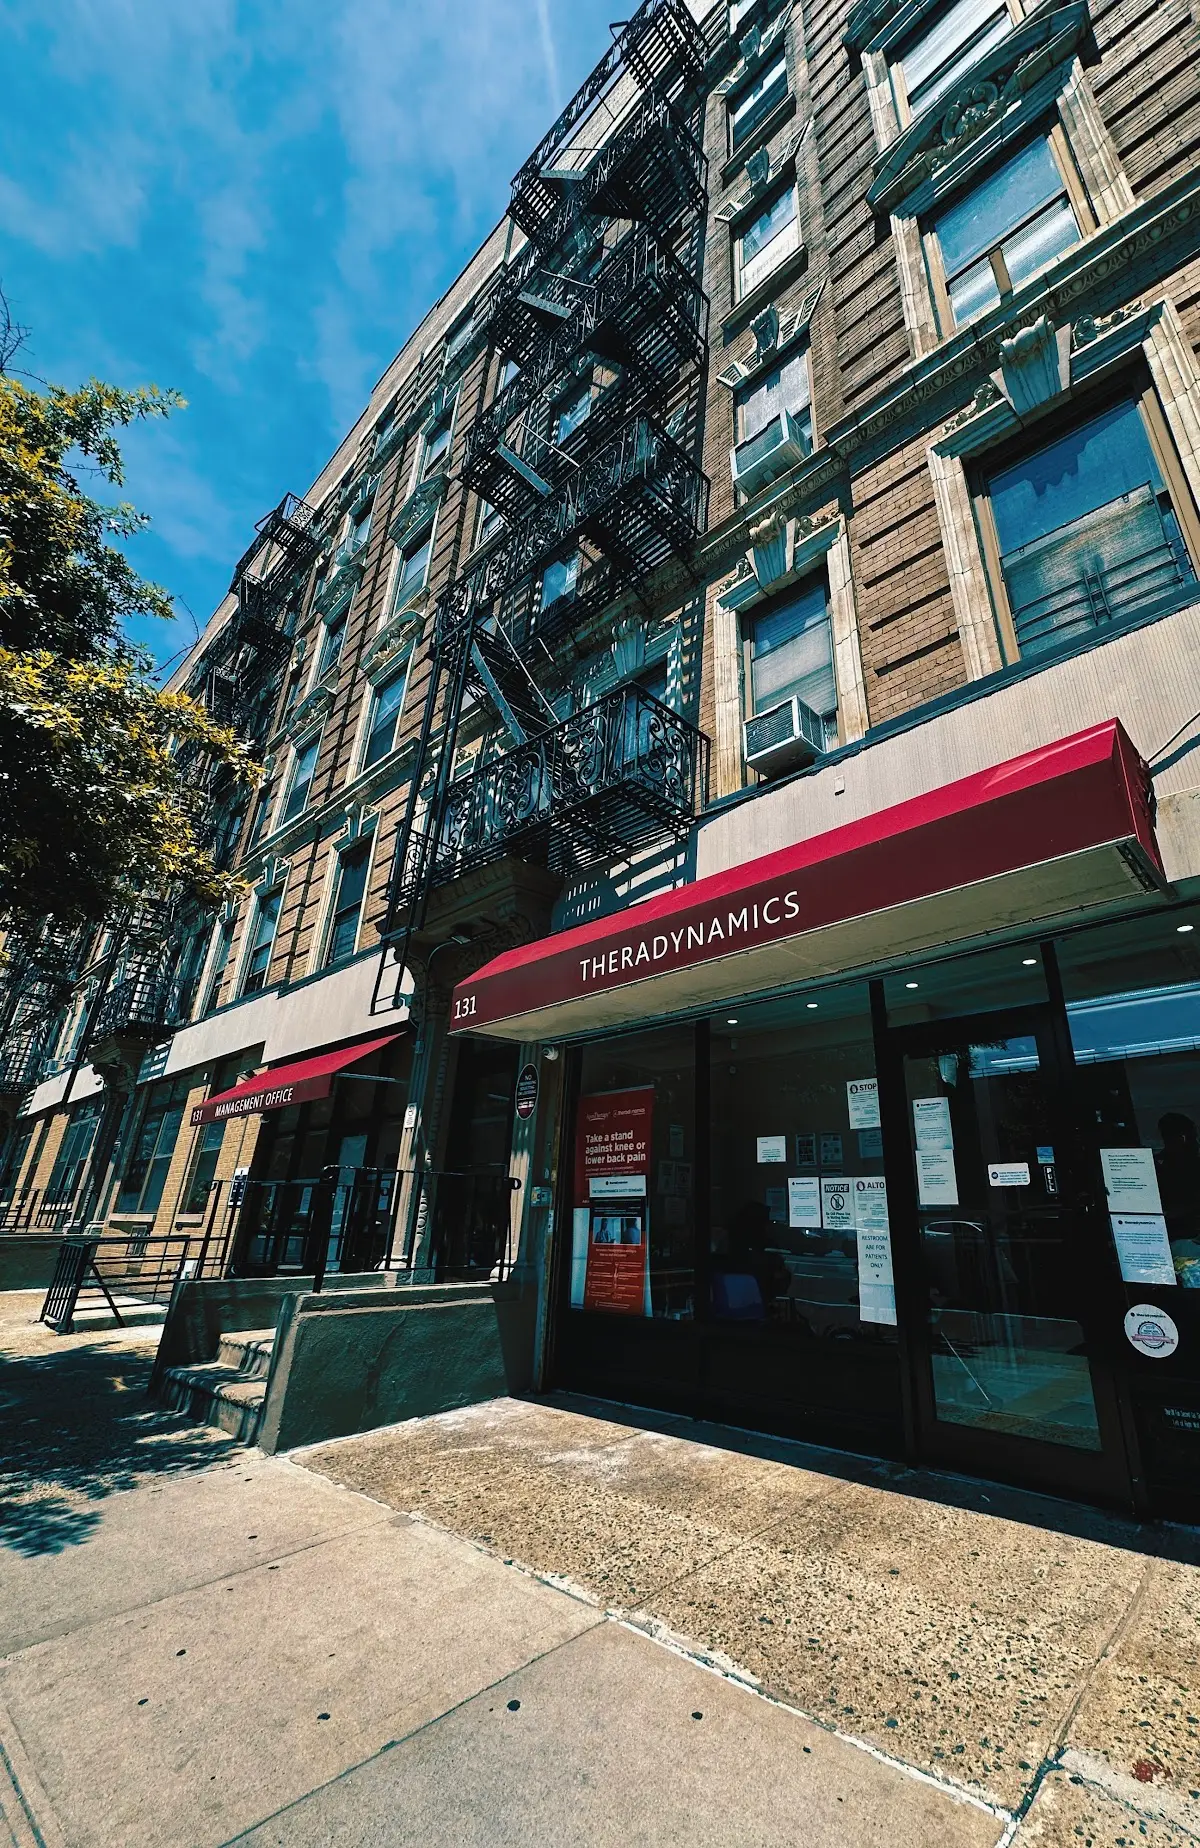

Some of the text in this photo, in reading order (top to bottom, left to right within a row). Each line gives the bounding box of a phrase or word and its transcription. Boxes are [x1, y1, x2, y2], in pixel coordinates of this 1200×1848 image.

[579, 890, 801, 982] THERADYNAMICS
[453, 994, 477, 1020] 131
[859, 1082, 877, 1091] STOP
[214, 1087, 294, 1118] MANAGEMENT OFFICE
[192, 1109, 203, 1122] 131
[585, 1133, 603, 1143] Take
[610, 1129, 634, 1141] stand
[585, 1141, 646, 1155] against knee or
[585, 1151, 646, 1165] lower back pain
[867, 1181, 885, 1189] ALTO
[1046, 1167, 1055, 1192] PULL
[825, 1184, 849, 1192] NOTICE
